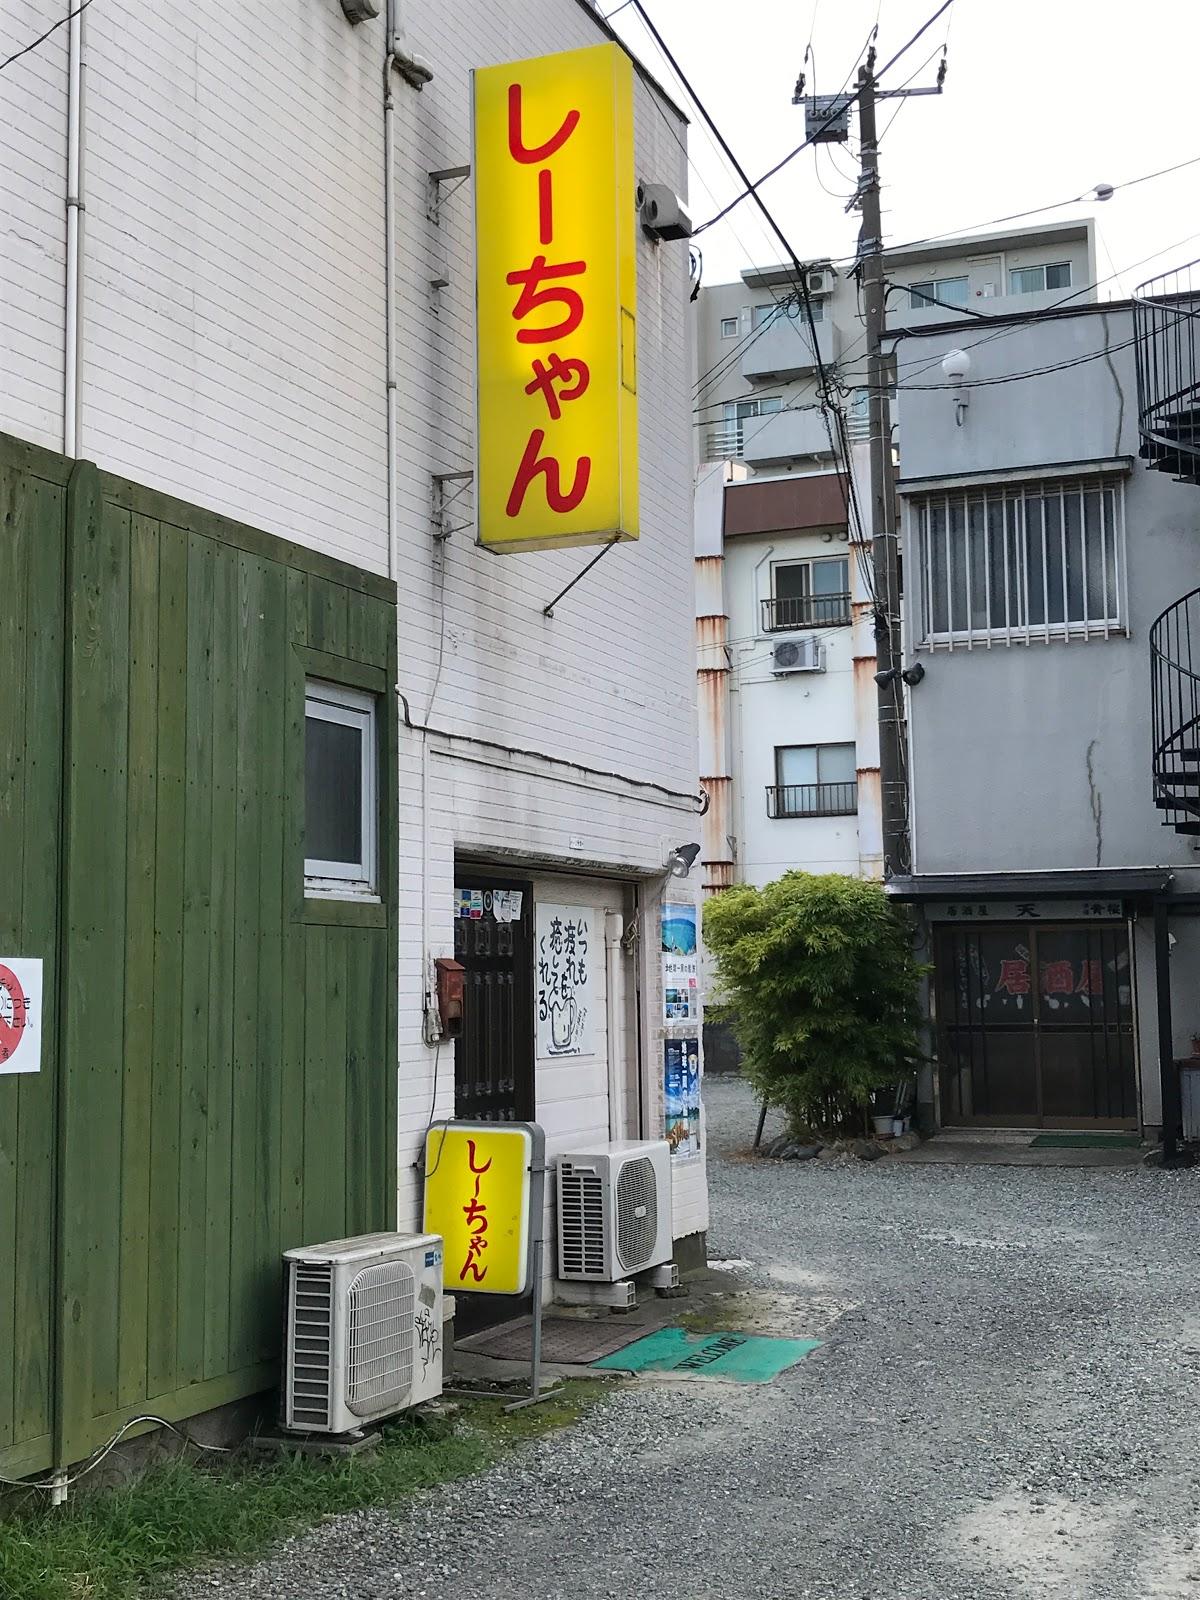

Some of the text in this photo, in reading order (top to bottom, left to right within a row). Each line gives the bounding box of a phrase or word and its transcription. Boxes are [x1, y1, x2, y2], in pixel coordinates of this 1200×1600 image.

[506, 83, 591, 517] しーちゃん
[1015, 903, 1041, 917] 天
[538, 935, 552, 1021] くれる
[577, 918, 588, 985] いつも
[459, 1139, 492, 1282] しーちゃん
[673, 1336, 747, 1370] WELCOME
